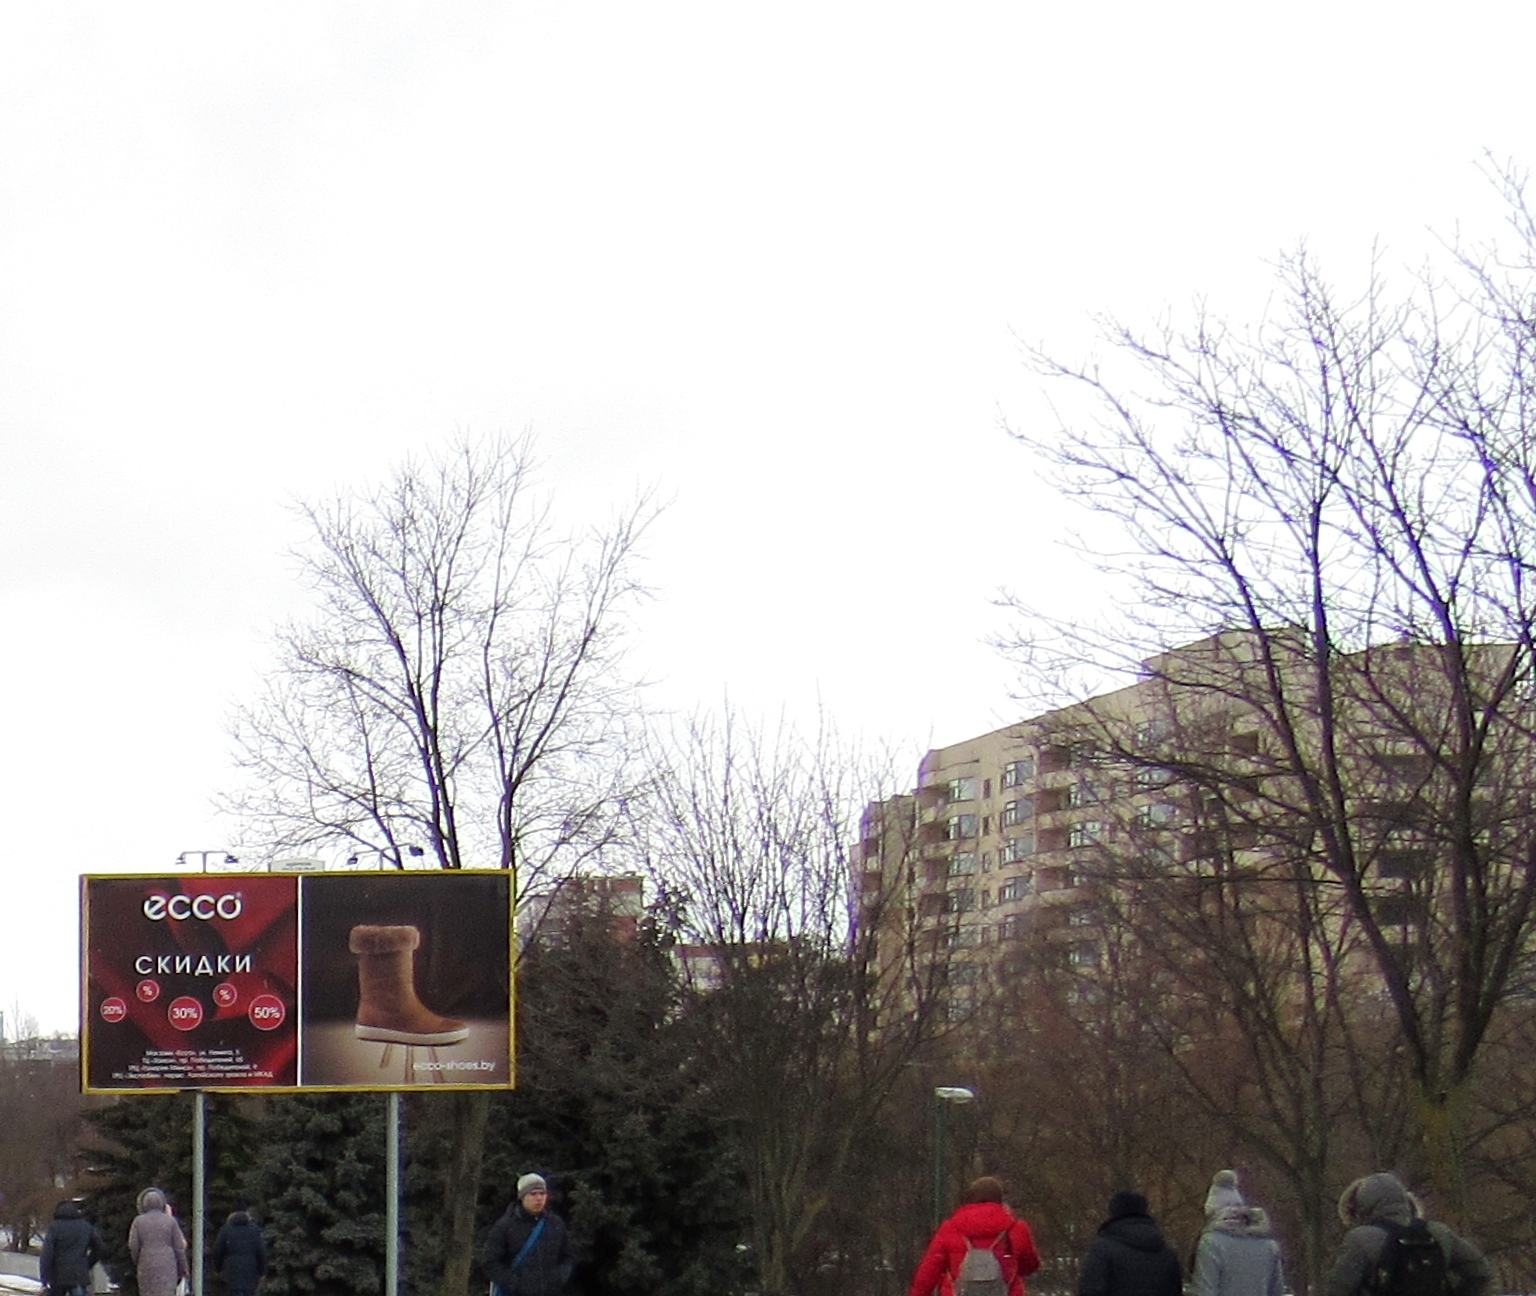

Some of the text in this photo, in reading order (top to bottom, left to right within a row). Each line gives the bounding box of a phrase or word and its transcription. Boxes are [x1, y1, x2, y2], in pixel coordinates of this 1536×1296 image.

[143, 894, 242, 920] ecco
[134, 954, 251, 976] СКИДКИ
[103, 1005, 123, 1014] 20%
[172, 1007, 198, 1019] 30%
[254, 1007, 281, 1019] 50%
